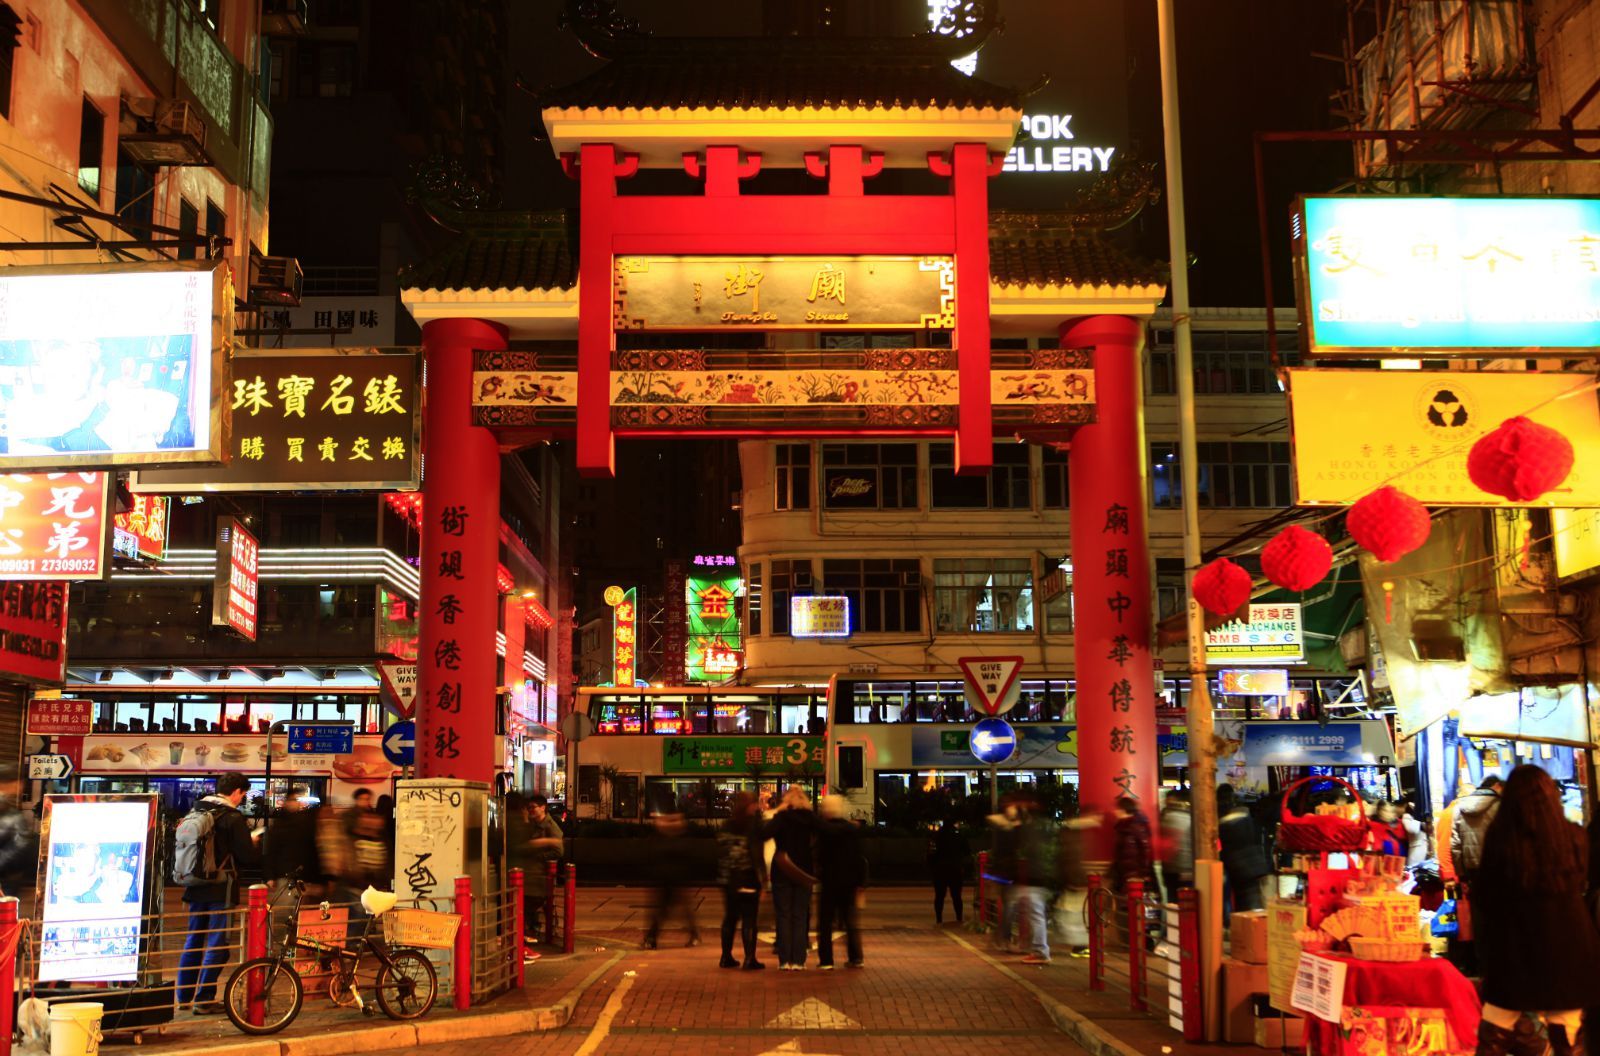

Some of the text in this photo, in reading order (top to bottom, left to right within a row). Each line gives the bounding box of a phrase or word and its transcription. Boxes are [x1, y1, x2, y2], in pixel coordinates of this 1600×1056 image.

[314, 309, 379, 329] 田園味
[720, 311, 849, 324] Temple Street
[232, 374, 408, 418] 珠寶名錶
[1330, 459, 1378, 469] HONG
[1388, 459, 1437, 469] KONG
[41, 559, 96, 572] 27309032
[1252, 608, 1295, 621] 找換店
[1211, 622, 1297, 635] ONEY EXCHANGE
[1209, 634, 1241, 643] RMB
[396, 667, 417, 675] GIVE
[980, 663, 1002, 672] GIVE
[397, 675, 417, 683] WAY
[981, 672, 1002, 680] WAY
[1318, 735, 1345, 744] 2999
